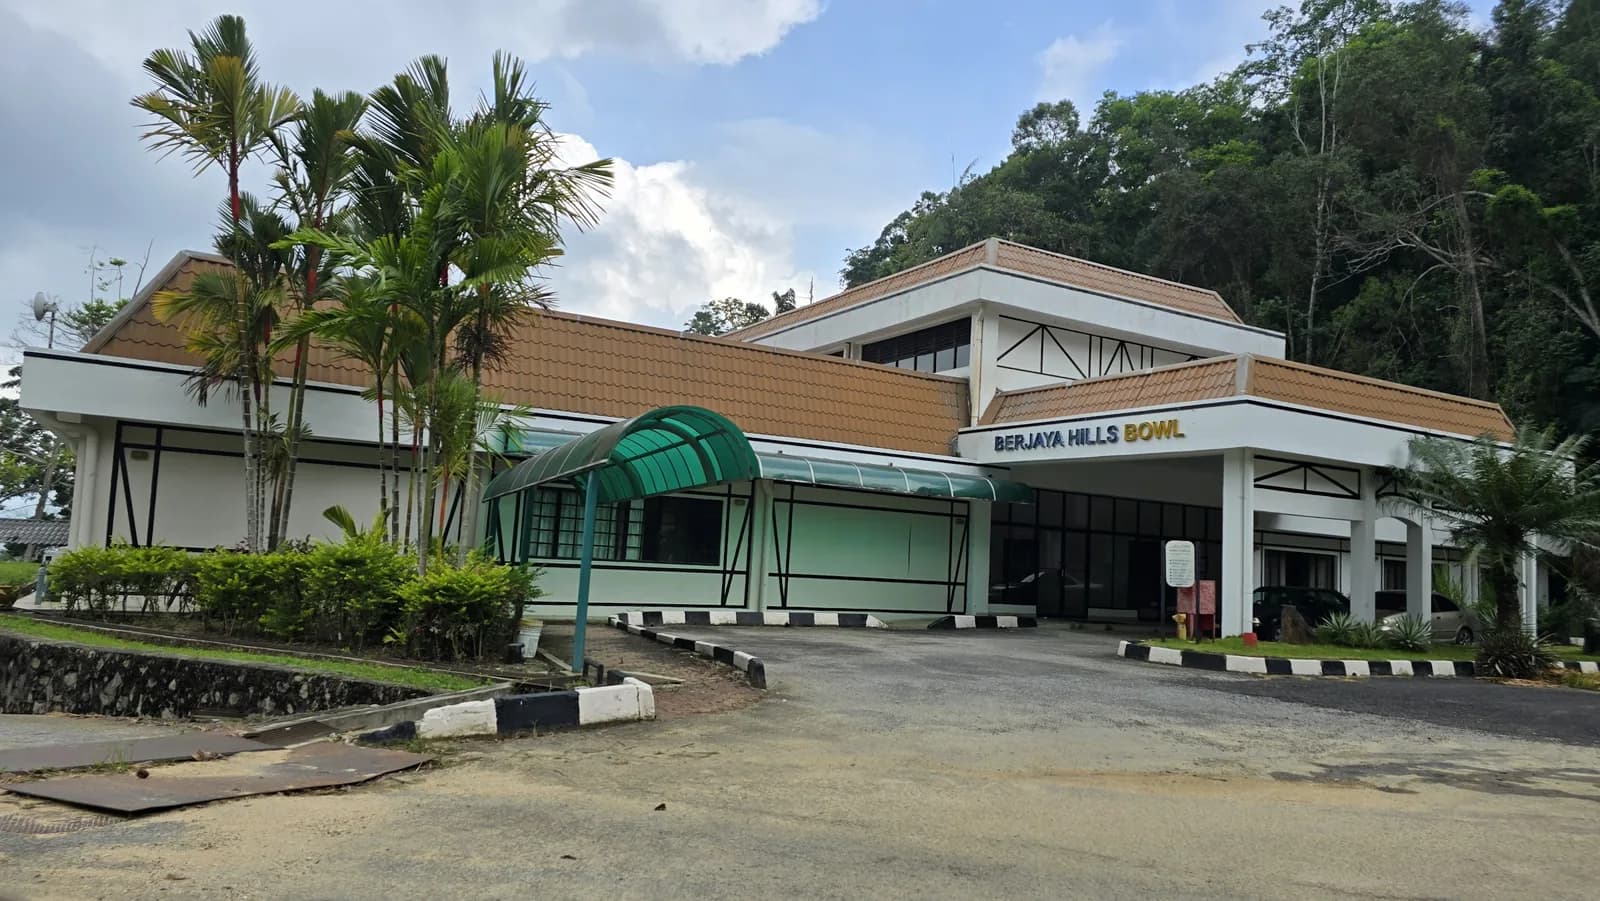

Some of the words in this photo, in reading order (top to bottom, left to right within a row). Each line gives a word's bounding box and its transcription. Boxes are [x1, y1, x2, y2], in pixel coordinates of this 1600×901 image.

[994, 430, 1064, 452] BERJAYA
[1068, 425, 1119, 446] HILLS
[1124, 419, 1185, 442] BOWL
